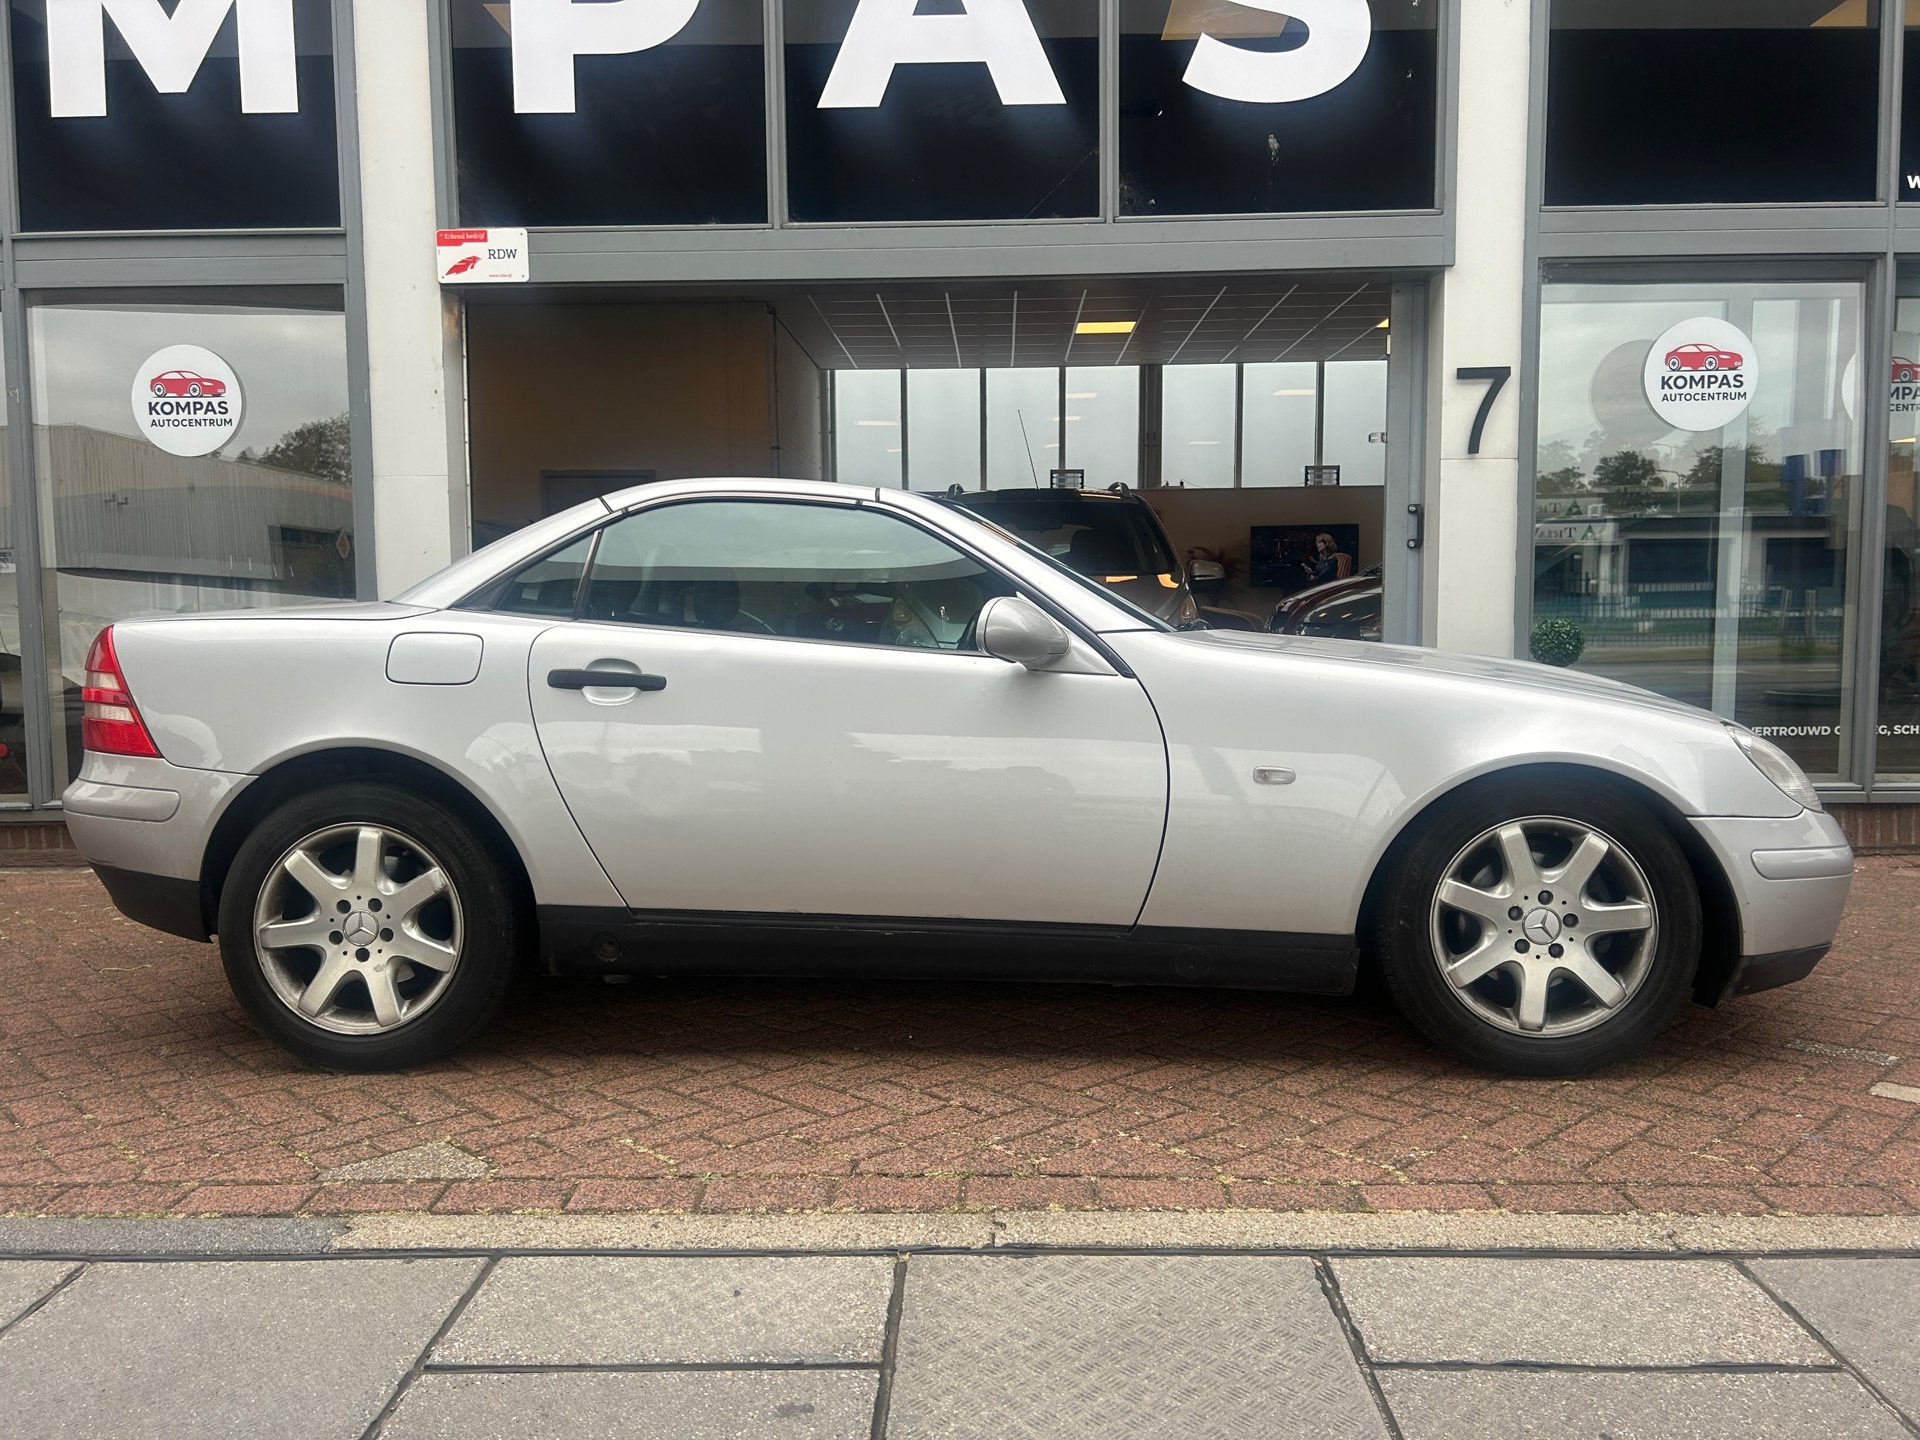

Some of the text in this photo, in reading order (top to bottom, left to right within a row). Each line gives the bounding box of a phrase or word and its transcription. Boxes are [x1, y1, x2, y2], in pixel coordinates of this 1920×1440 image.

[444, 232, 485, 241] Erkend bedrijf
[487, 248, 518, 260] RDW
[1660, 374, 1744, 390] KOMPAS
[1661, 391, 1747, 402] AUTOCENTRUM
[148, 400, 229, 416] KOMPAS
[1456, 366, 1511, 454] 7
[150, 418, 233, 428] AUTOCENTRUM
[1751, 725, 1831, 737] ERTROUWD
